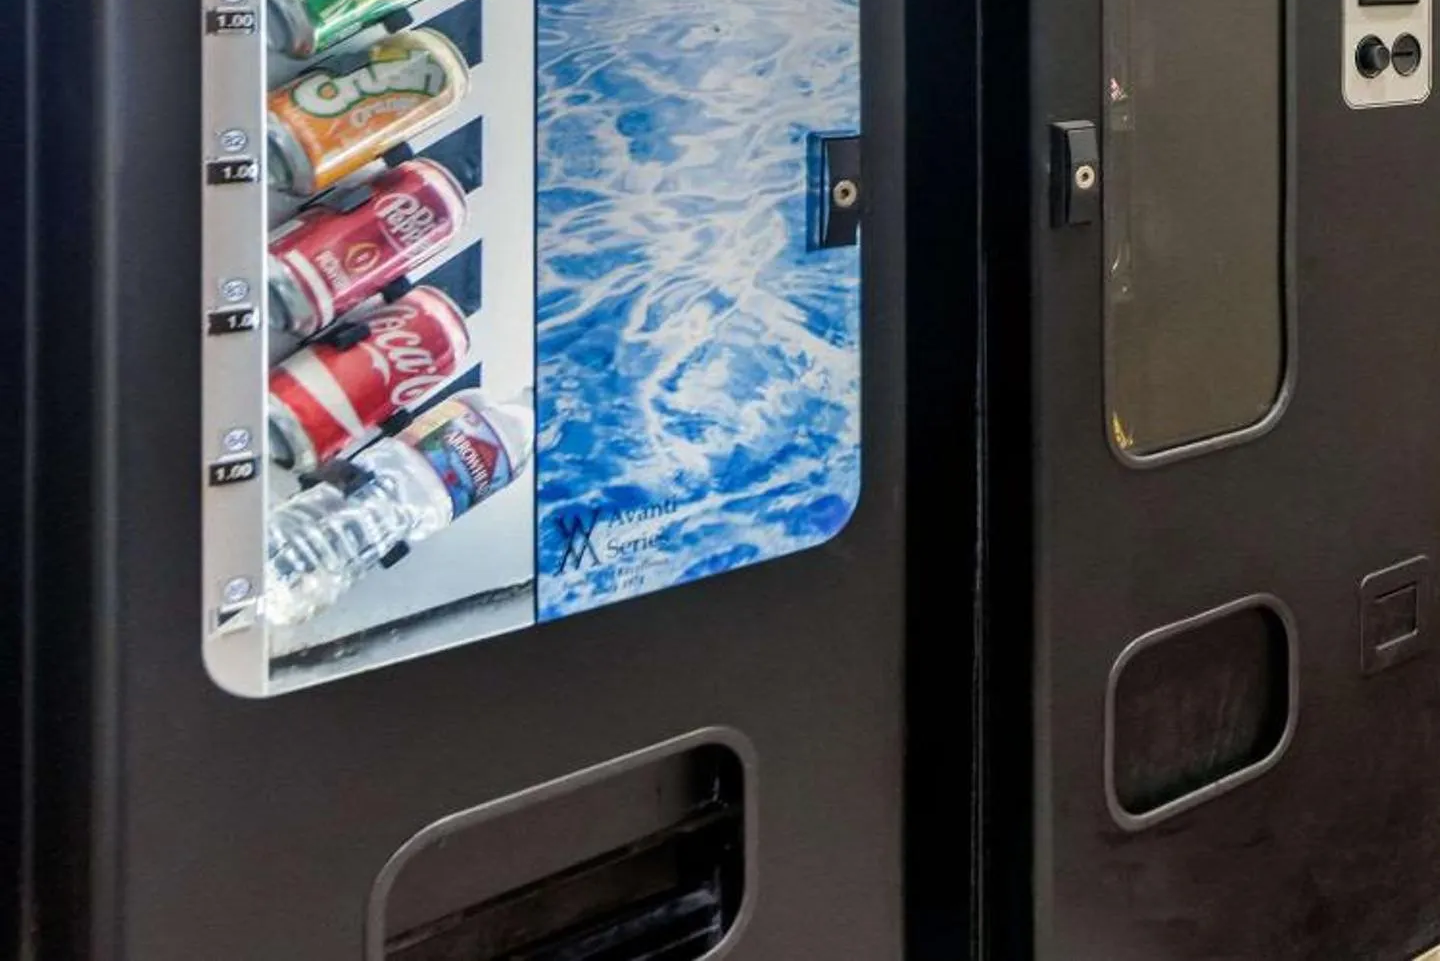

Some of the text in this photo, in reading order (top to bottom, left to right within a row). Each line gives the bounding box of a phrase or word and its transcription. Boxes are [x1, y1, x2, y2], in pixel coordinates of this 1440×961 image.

[217, 14, 253, 28] 1.00
[228, 313, 255, 329] 1.0
[215, 462, 252, 481] 1.00
